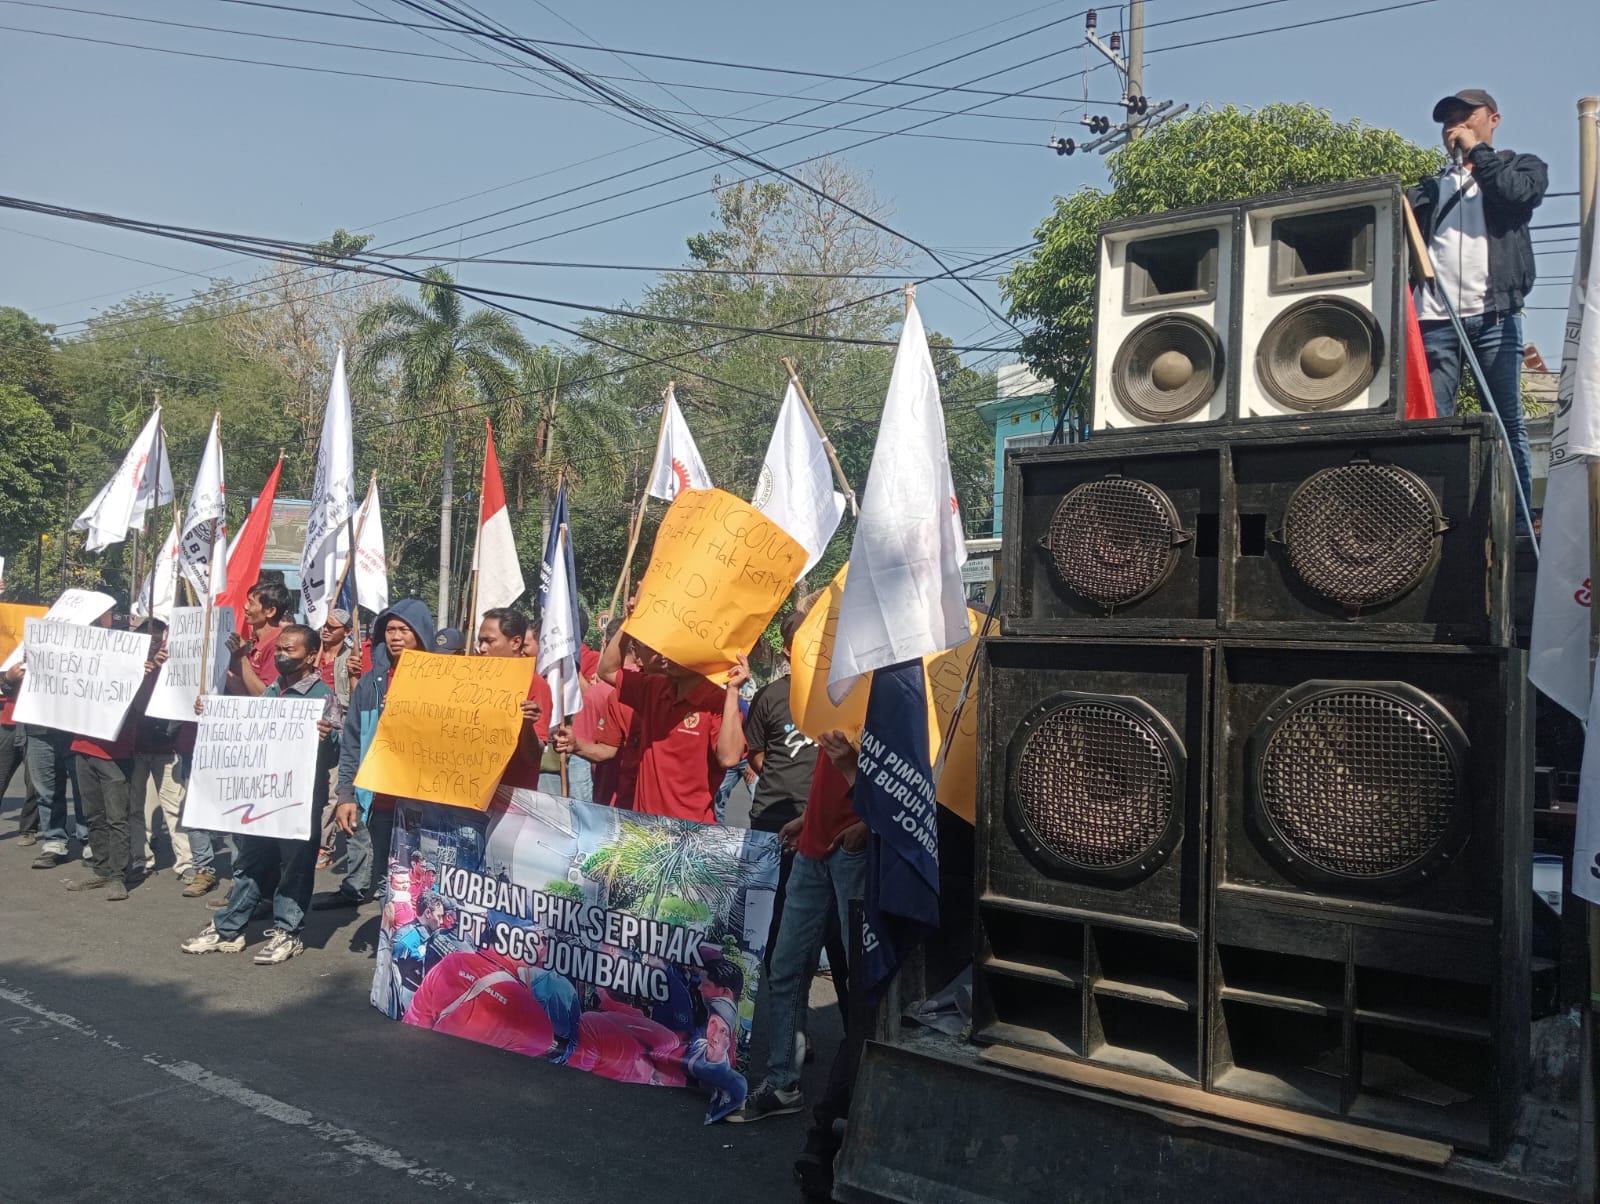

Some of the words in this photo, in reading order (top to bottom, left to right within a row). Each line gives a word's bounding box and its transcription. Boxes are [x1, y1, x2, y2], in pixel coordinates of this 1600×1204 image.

[873, 769, 927, 818] BURUH
[439, 862, 529, 920] KORBAN
[531, 889, 584, 937] PHK
[587, 905, 706, 967] SEPIHAK
[456, 908, 490, 950] PT.
[493, 920, 541, 966] SGS
[542, 937, 670, 1003] JOMBANG
